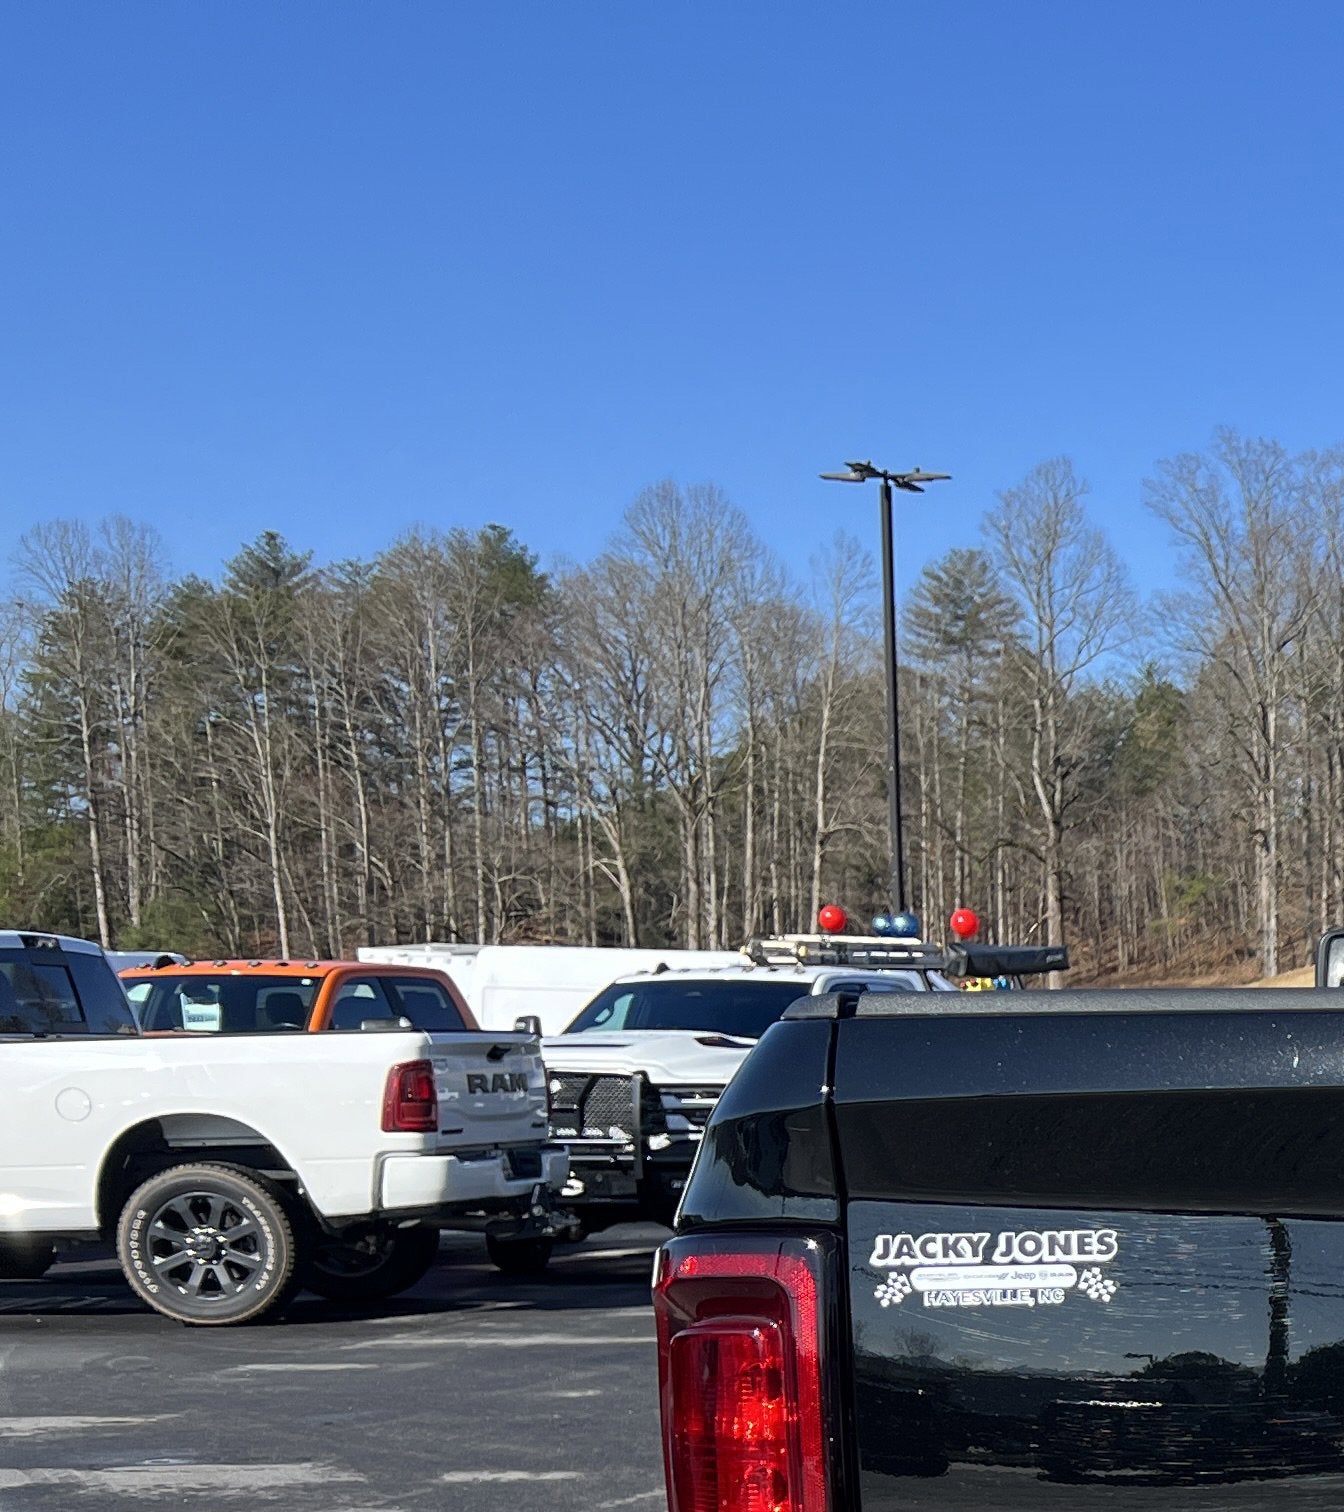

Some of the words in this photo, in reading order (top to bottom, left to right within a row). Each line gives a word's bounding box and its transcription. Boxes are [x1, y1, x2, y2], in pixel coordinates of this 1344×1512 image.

[466, 1072, 529, 1094] RAM
[869, 1232, 991, 1266] JACKY
[992, 1230, 1118, 1263] JONES
[1011, 1271, 1036, 1281] Jeep
[1037, 1288, 1065, 1304] NC
